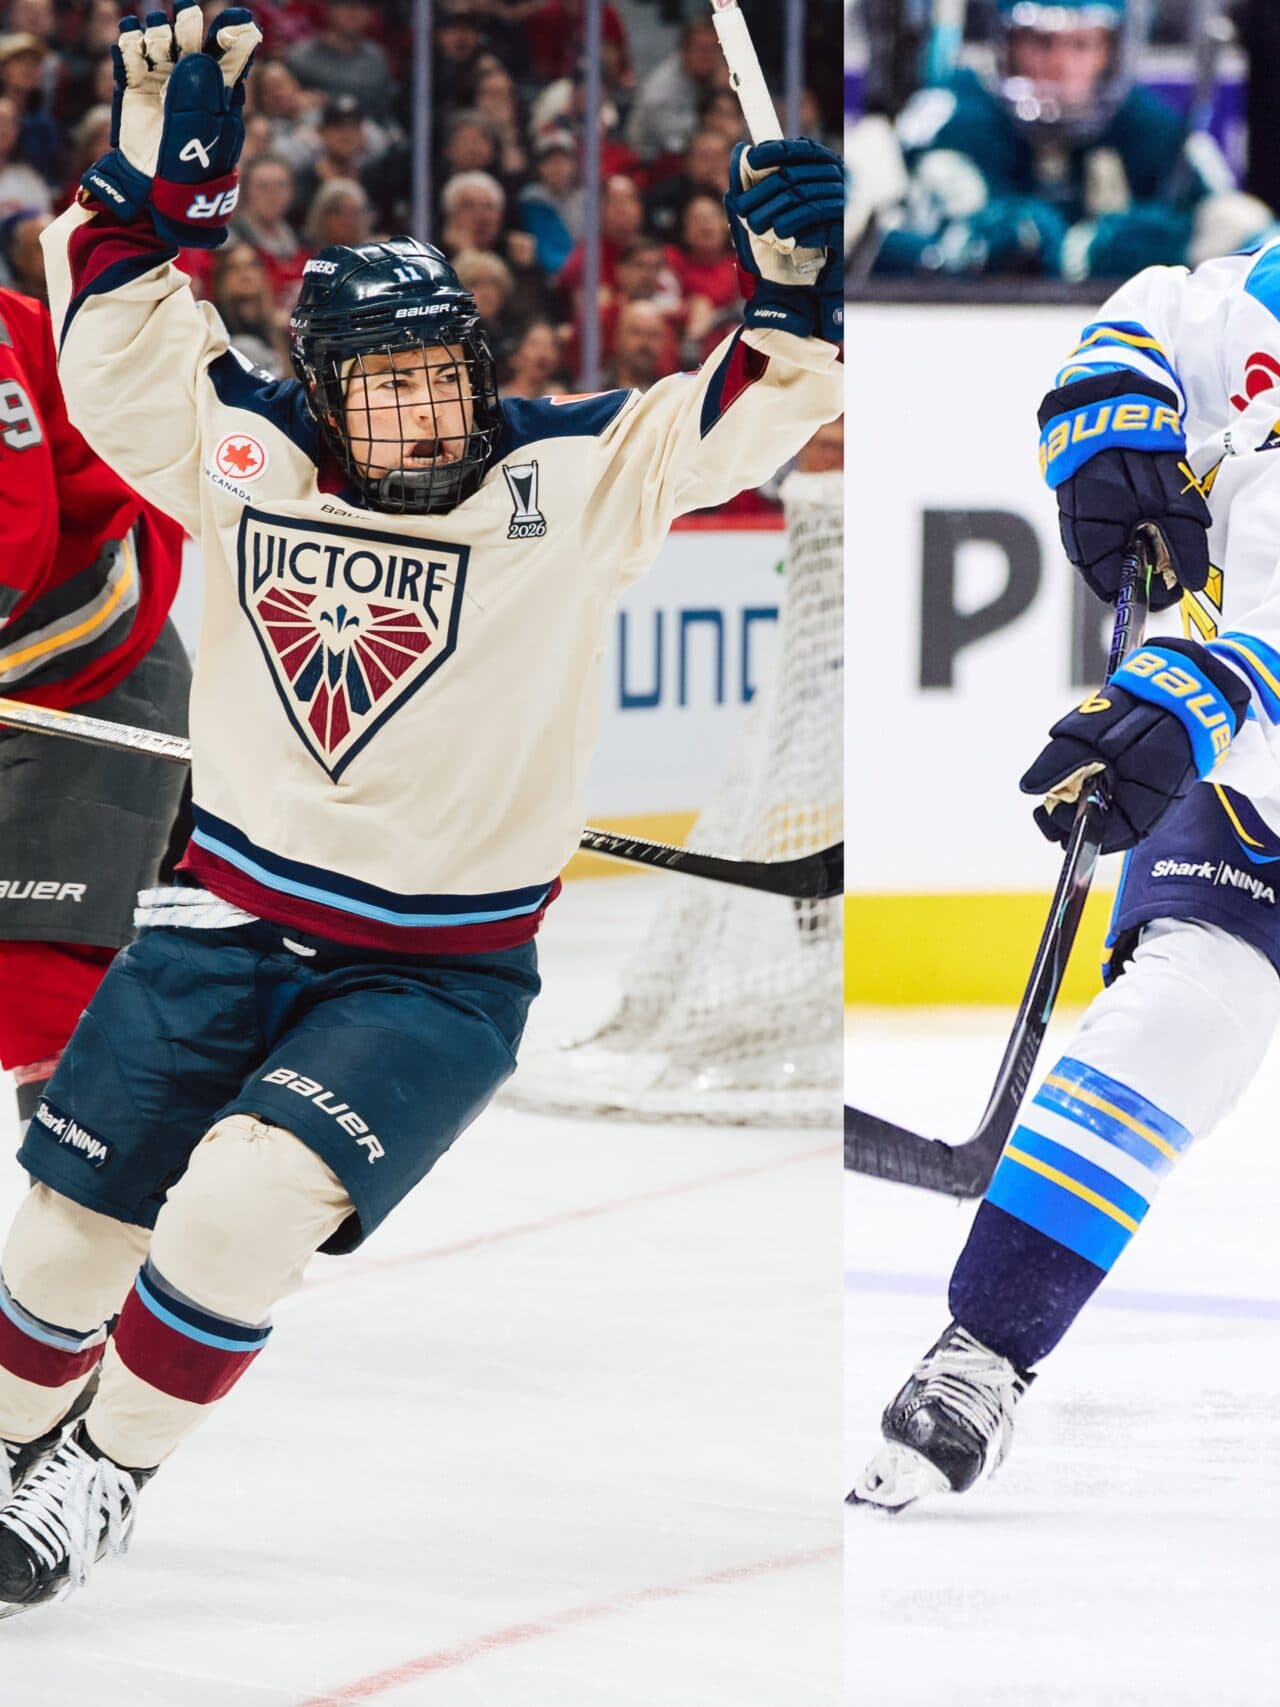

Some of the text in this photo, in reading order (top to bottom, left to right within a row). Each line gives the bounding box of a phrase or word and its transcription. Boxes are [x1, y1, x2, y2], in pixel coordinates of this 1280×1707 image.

[211, 474, 252, 503] CANADA
[508, 521, 547, 538] 2026
[253, 532, 448, 630] VICTOIRE
[0, 880, 88, 903] AUER
